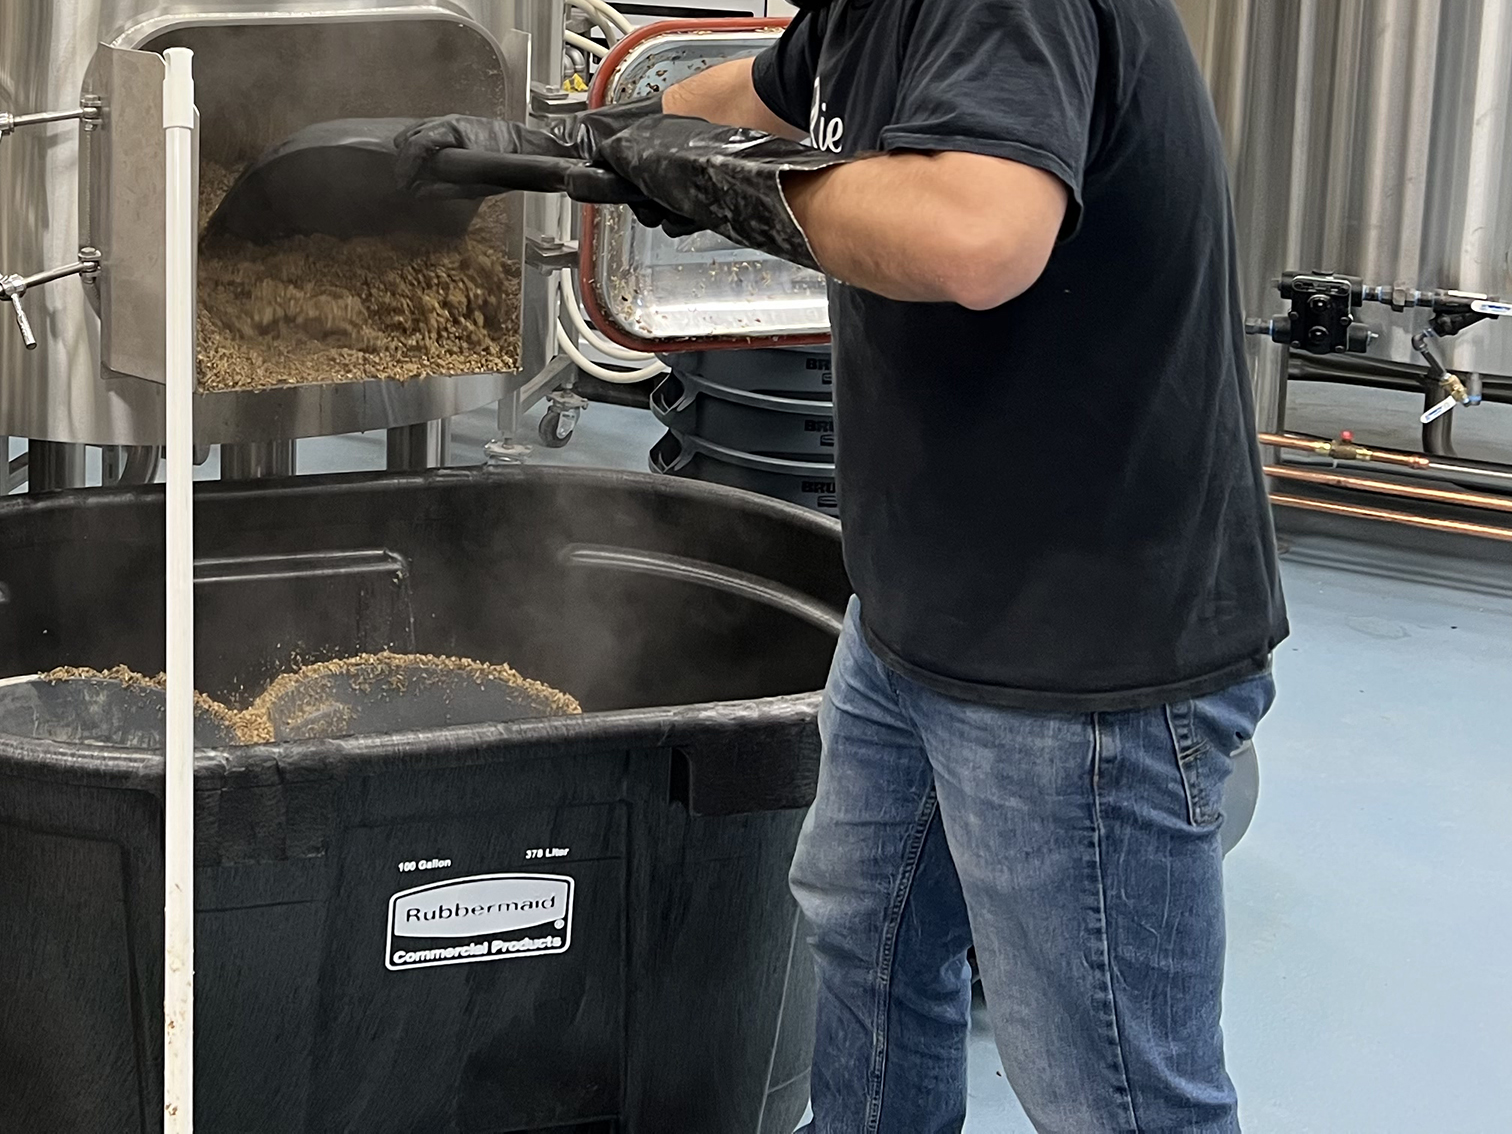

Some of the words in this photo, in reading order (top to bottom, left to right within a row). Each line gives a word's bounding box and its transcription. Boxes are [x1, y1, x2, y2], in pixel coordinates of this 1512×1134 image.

[525, 848, 544, 860] 378
[545, 846, 570, 858] Liter
[398, 860, 416, 873] 100
[418, 857, 452, 870] Gallon
[406, 894, 556, 923] Rubbermaid
[393, 941, 489, 964] Commercial
[491, 935, 562, 954] Products
